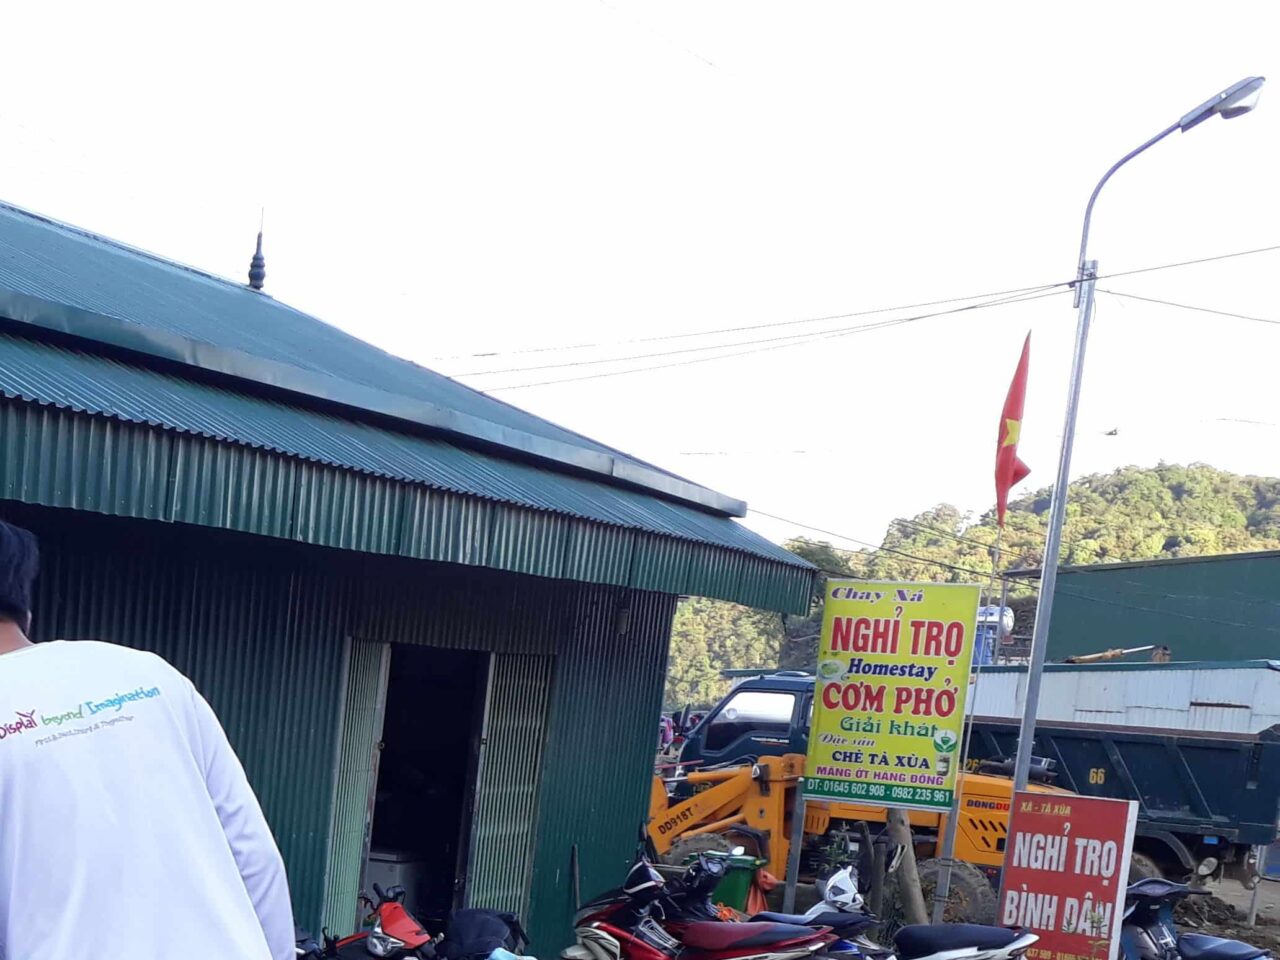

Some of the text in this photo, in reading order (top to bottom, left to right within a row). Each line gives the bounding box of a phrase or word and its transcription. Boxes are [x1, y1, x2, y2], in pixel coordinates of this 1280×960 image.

[831, 605, 965, 666] NGHỈ TRỌ
[847, 657, 939, 682] Homestay
[41, 704, 85, 726] beyond
[85, 685, 161, 716] Imagination
[823, 678, 959, 718] CƠM PHỞ
[840, 716, 939, 738] Giải khát
[832, 749, 931, 770] CHÈ TÀ XÙA
[824, 781, 849, 793] 01645
[851, 783, 867, 795] 602
[869, 785, 886, 796] 908
[892, 786, 913, 799] 0982
[915, 789, 932, 801] 235
[933, 790, 950, 802] 961
[1089, 768, 1106, 784] 66
[1012, 822, 1118, 886] NGHỈ TRỌ
[1003, 884, 1058, 930] BÌNH
